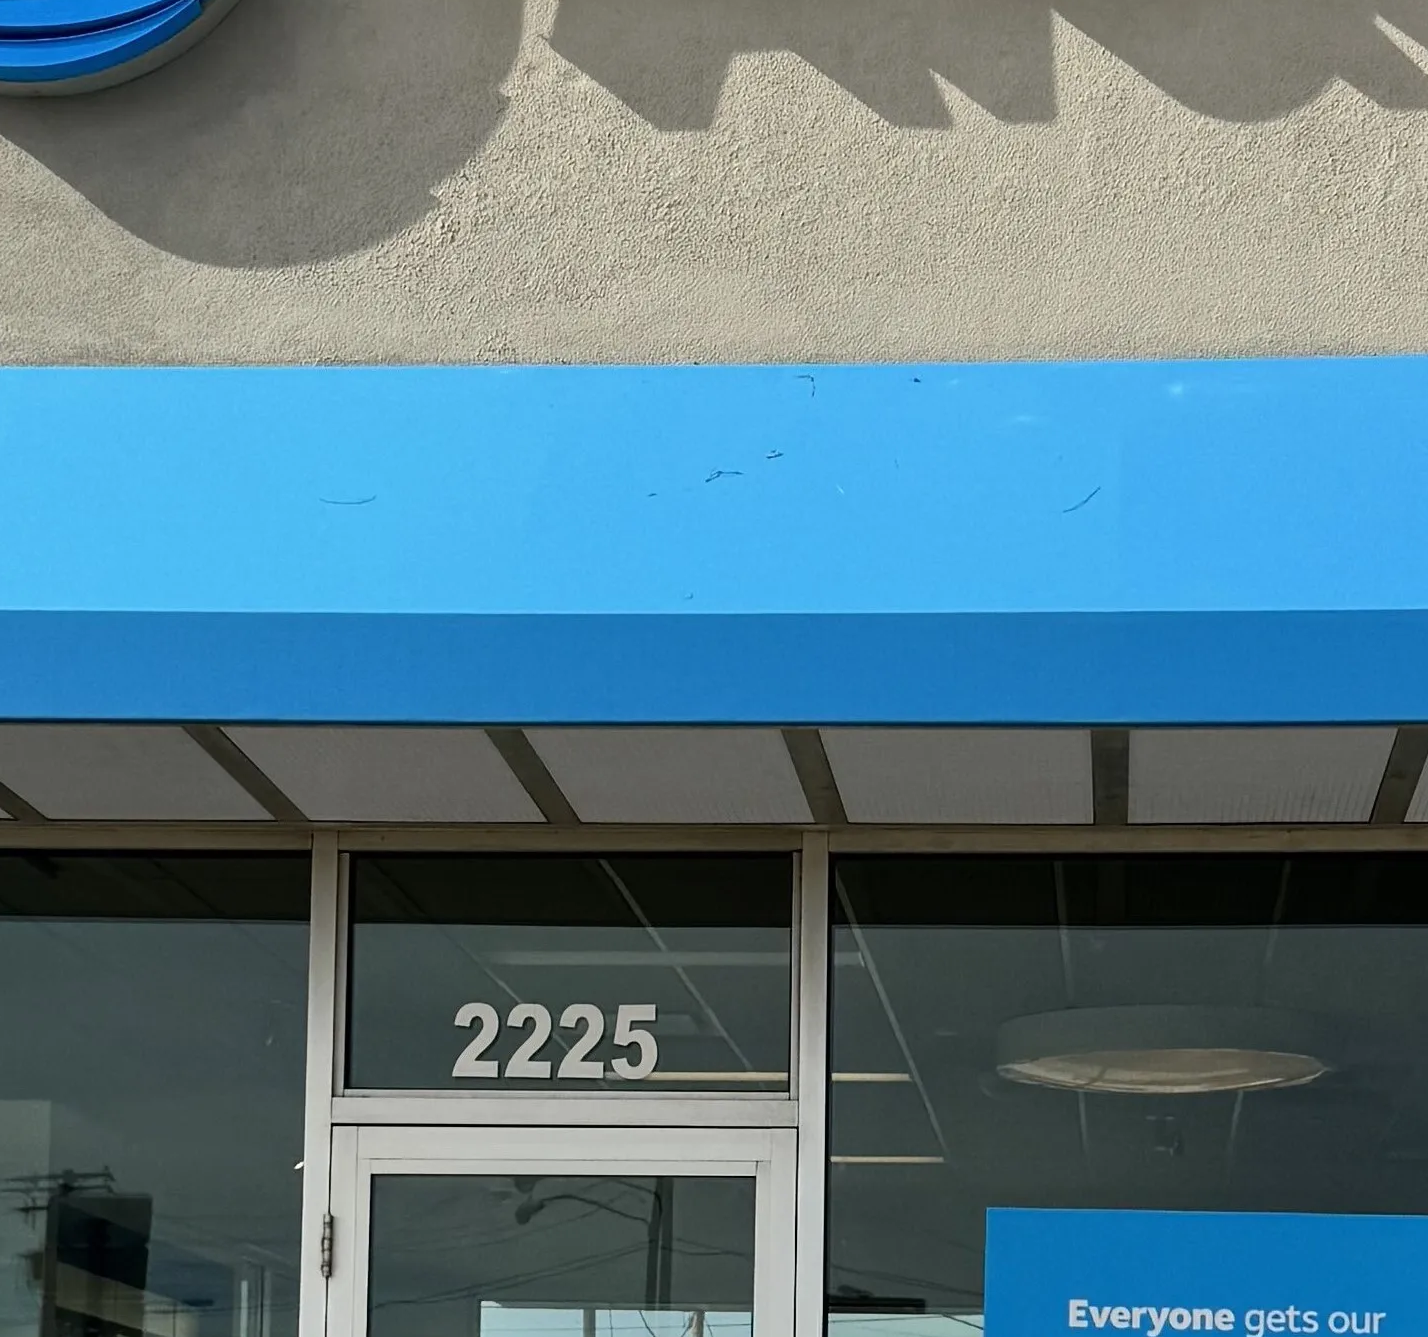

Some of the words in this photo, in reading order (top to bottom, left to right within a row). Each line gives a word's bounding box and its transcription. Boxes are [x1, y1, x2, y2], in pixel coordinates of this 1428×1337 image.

[452, 1002, 659, 1080] 2225
[1068, 1299, 1235, 1337] Everyone
[1328, 1310, 1387, 1334] our
